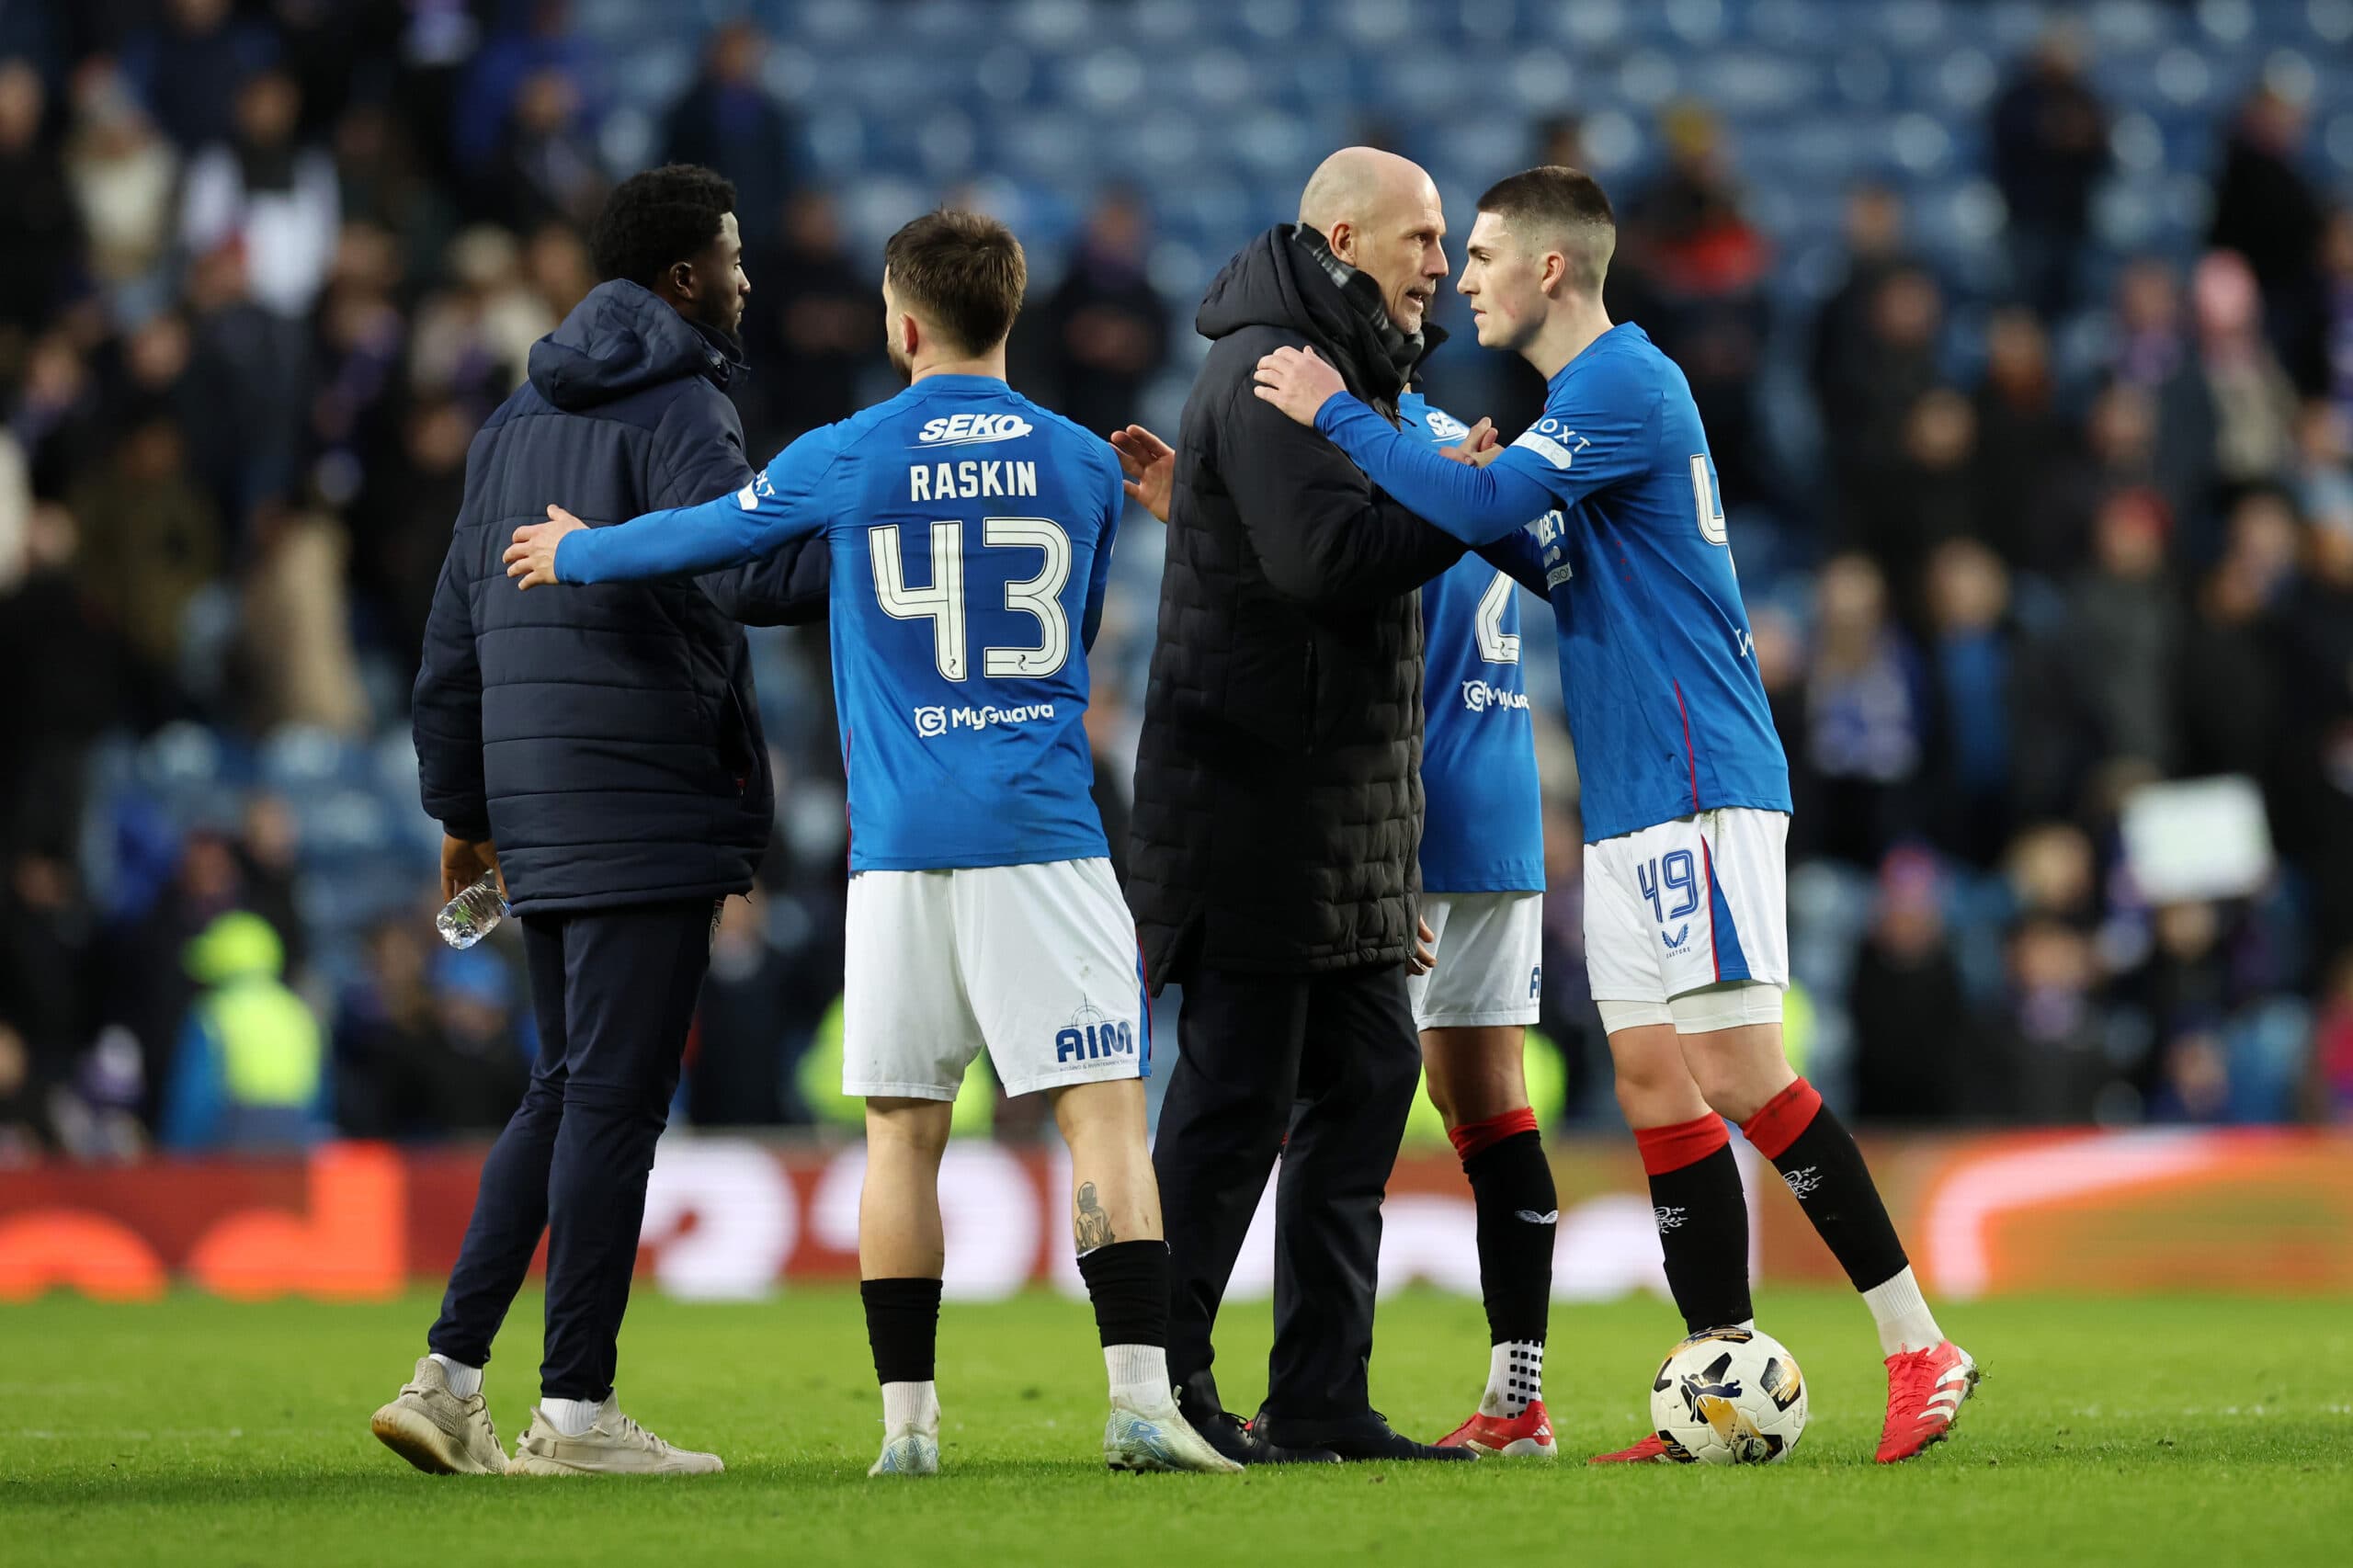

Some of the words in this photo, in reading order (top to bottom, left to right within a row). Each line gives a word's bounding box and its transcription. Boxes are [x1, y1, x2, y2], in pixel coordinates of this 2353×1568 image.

[919, 414, 1033, 443] SEKO
[909, 460, 1038, 502] RASKIN
[868, 517, 1073, 682] 43
[952, 704, 1054, 731] MyGuava
[1637, 848, 1699, 924] 49
[1055, 1021, 1133, 1063] AIM
